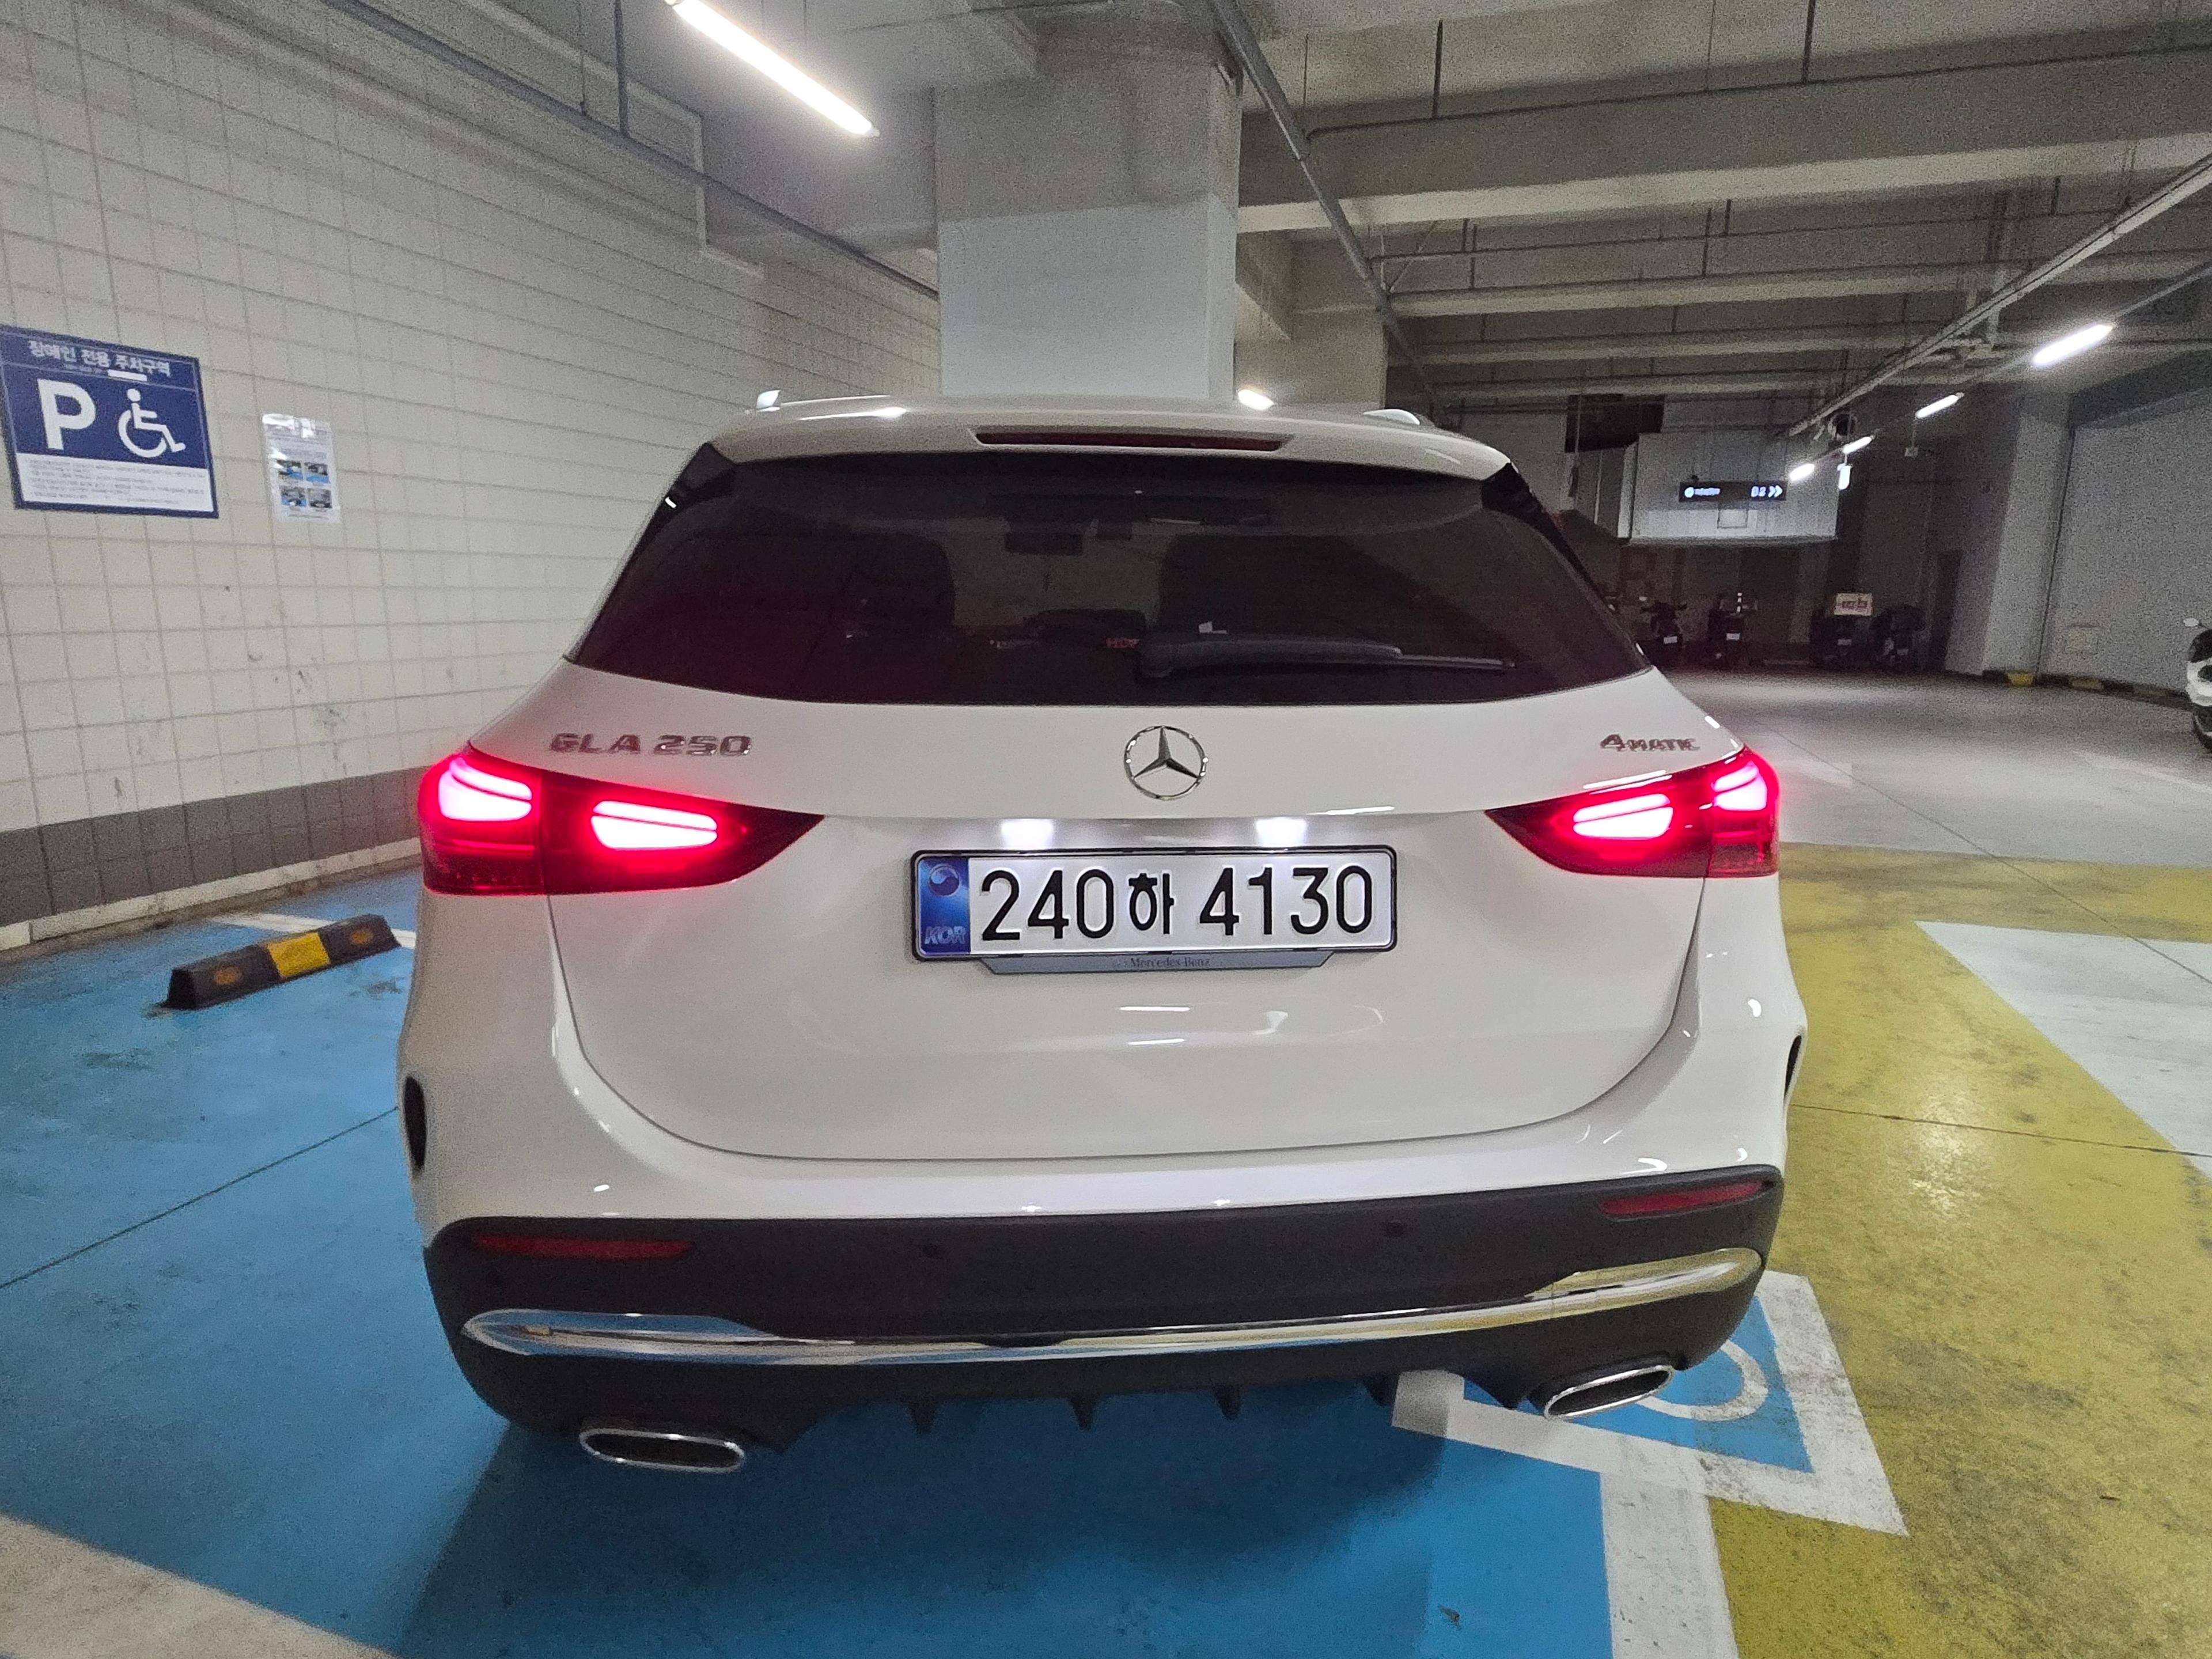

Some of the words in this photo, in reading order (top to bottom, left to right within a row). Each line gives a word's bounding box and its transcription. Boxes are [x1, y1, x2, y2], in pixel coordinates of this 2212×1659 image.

[28, 340, 77, 362] 장애인
[81, 349, 111, 368] 전용
[37, 378, 96, 450] P
[550, 733, 641, 754] GLA
[653, 734, 751, 756] 250
[1600, 734, 1700, 752] 4MATIC
[982, 869, 1175, 941] 240하
[1199, 865, 1372, 935] 4130
[924, 926, 967, 945] KOR
[1131, 957, 1211, 968] Mercedes-Benz
